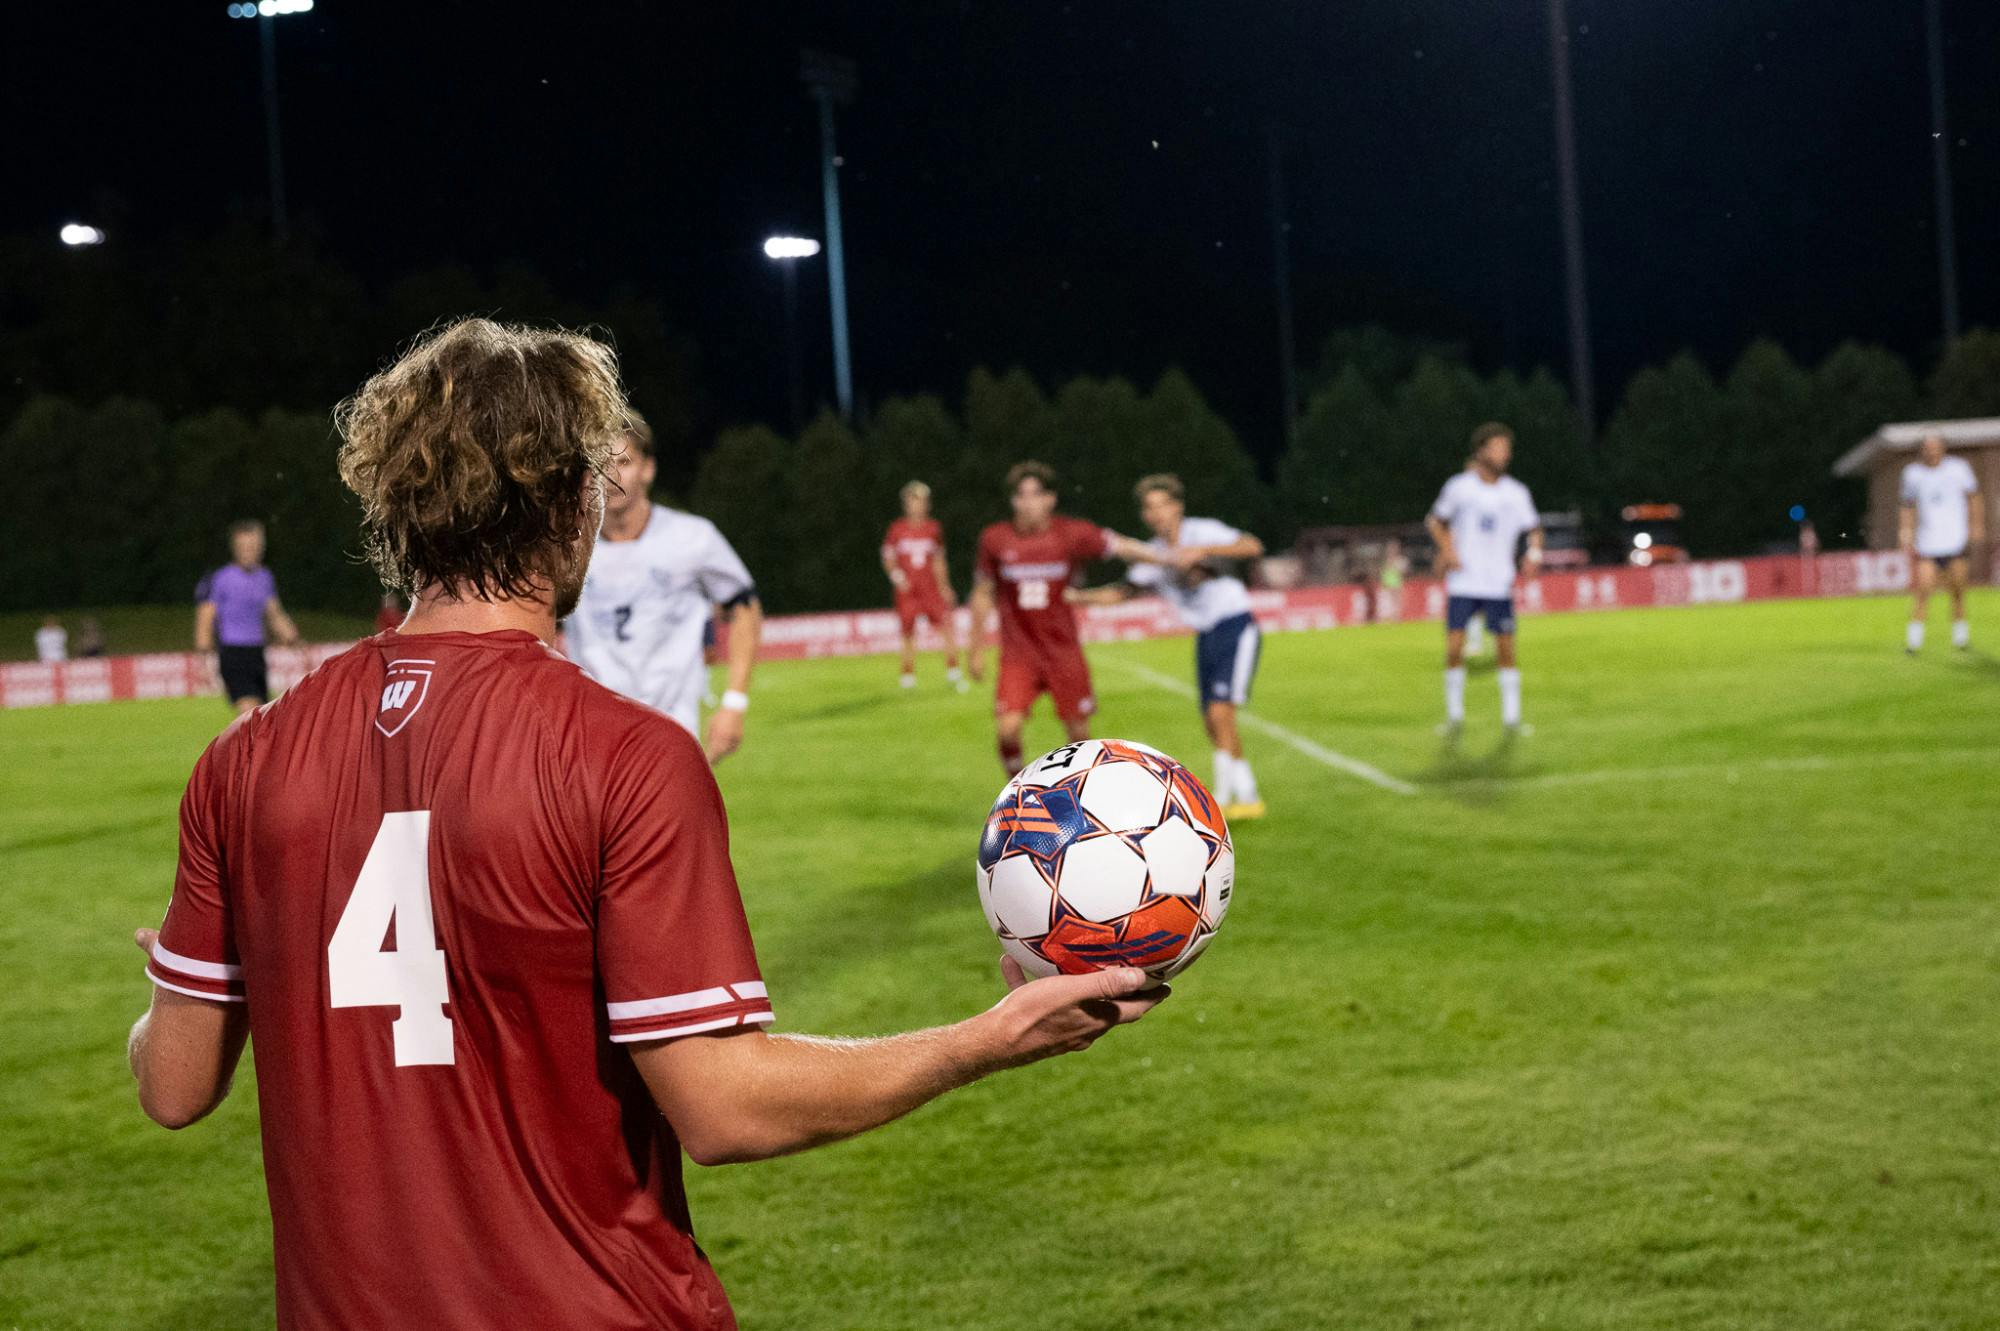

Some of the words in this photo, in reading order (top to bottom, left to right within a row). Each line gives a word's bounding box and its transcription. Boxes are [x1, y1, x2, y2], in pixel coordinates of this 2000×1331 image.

[615, 604, 632, 642] 2
[381, 680, 417, 713] W
[327, 810, 456, 1068] 4
